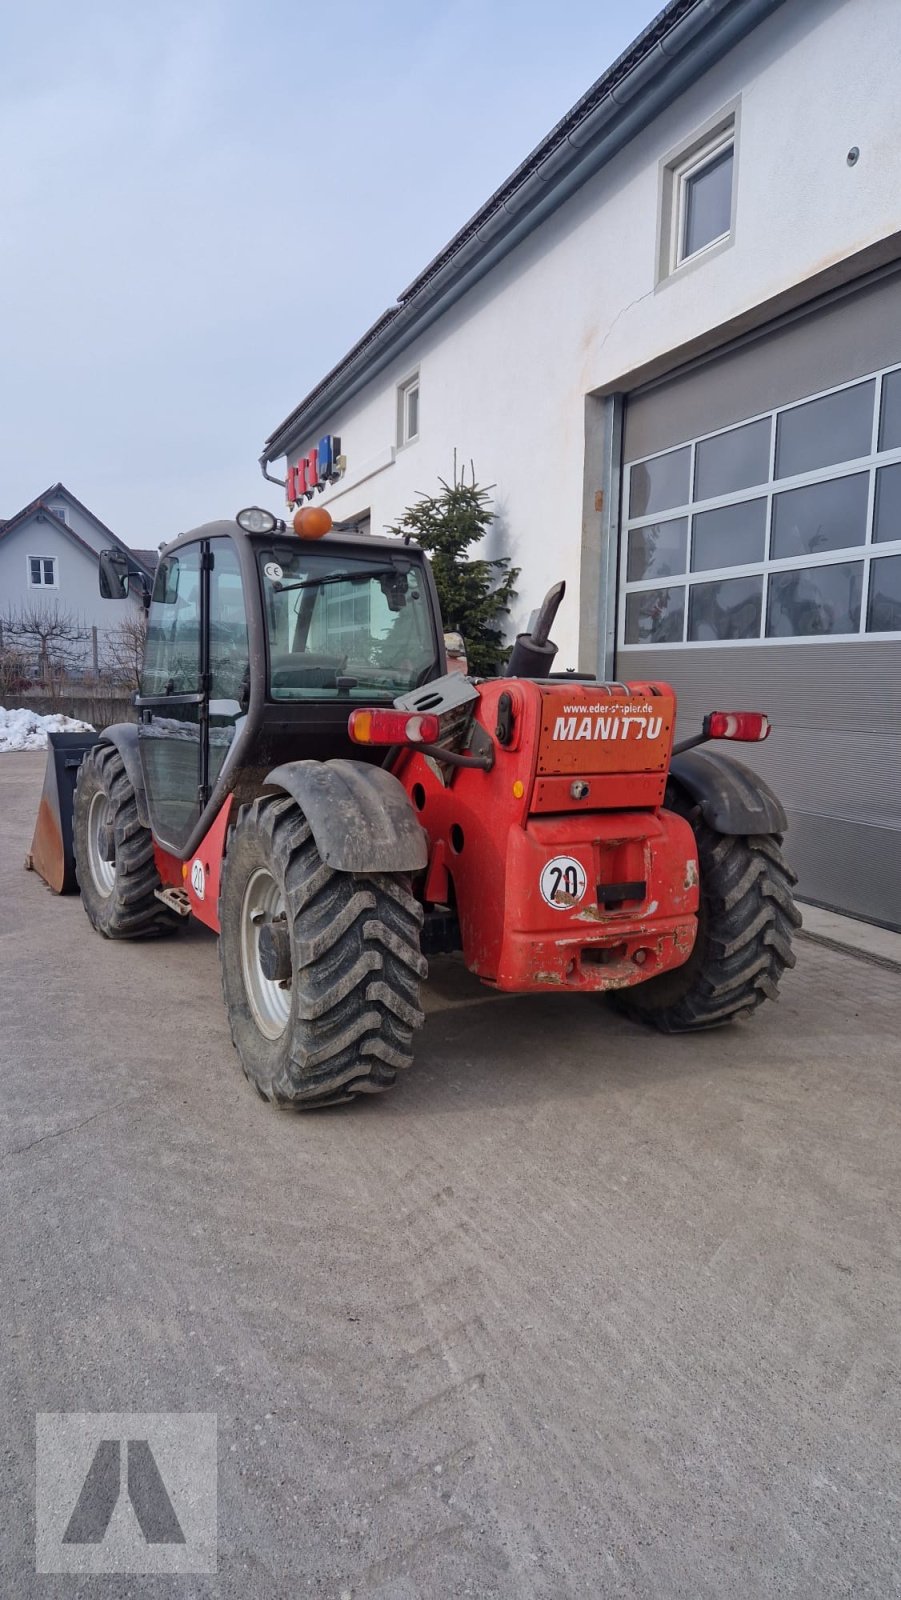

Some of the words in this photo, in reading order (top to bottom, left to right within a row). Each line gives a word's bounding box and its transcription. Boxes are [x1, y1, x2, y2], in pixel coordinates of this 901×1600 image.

[265, 566, 280, 577] CE
[193, 865, 203, 893] 20
[550, 866, 577, 900] 20
